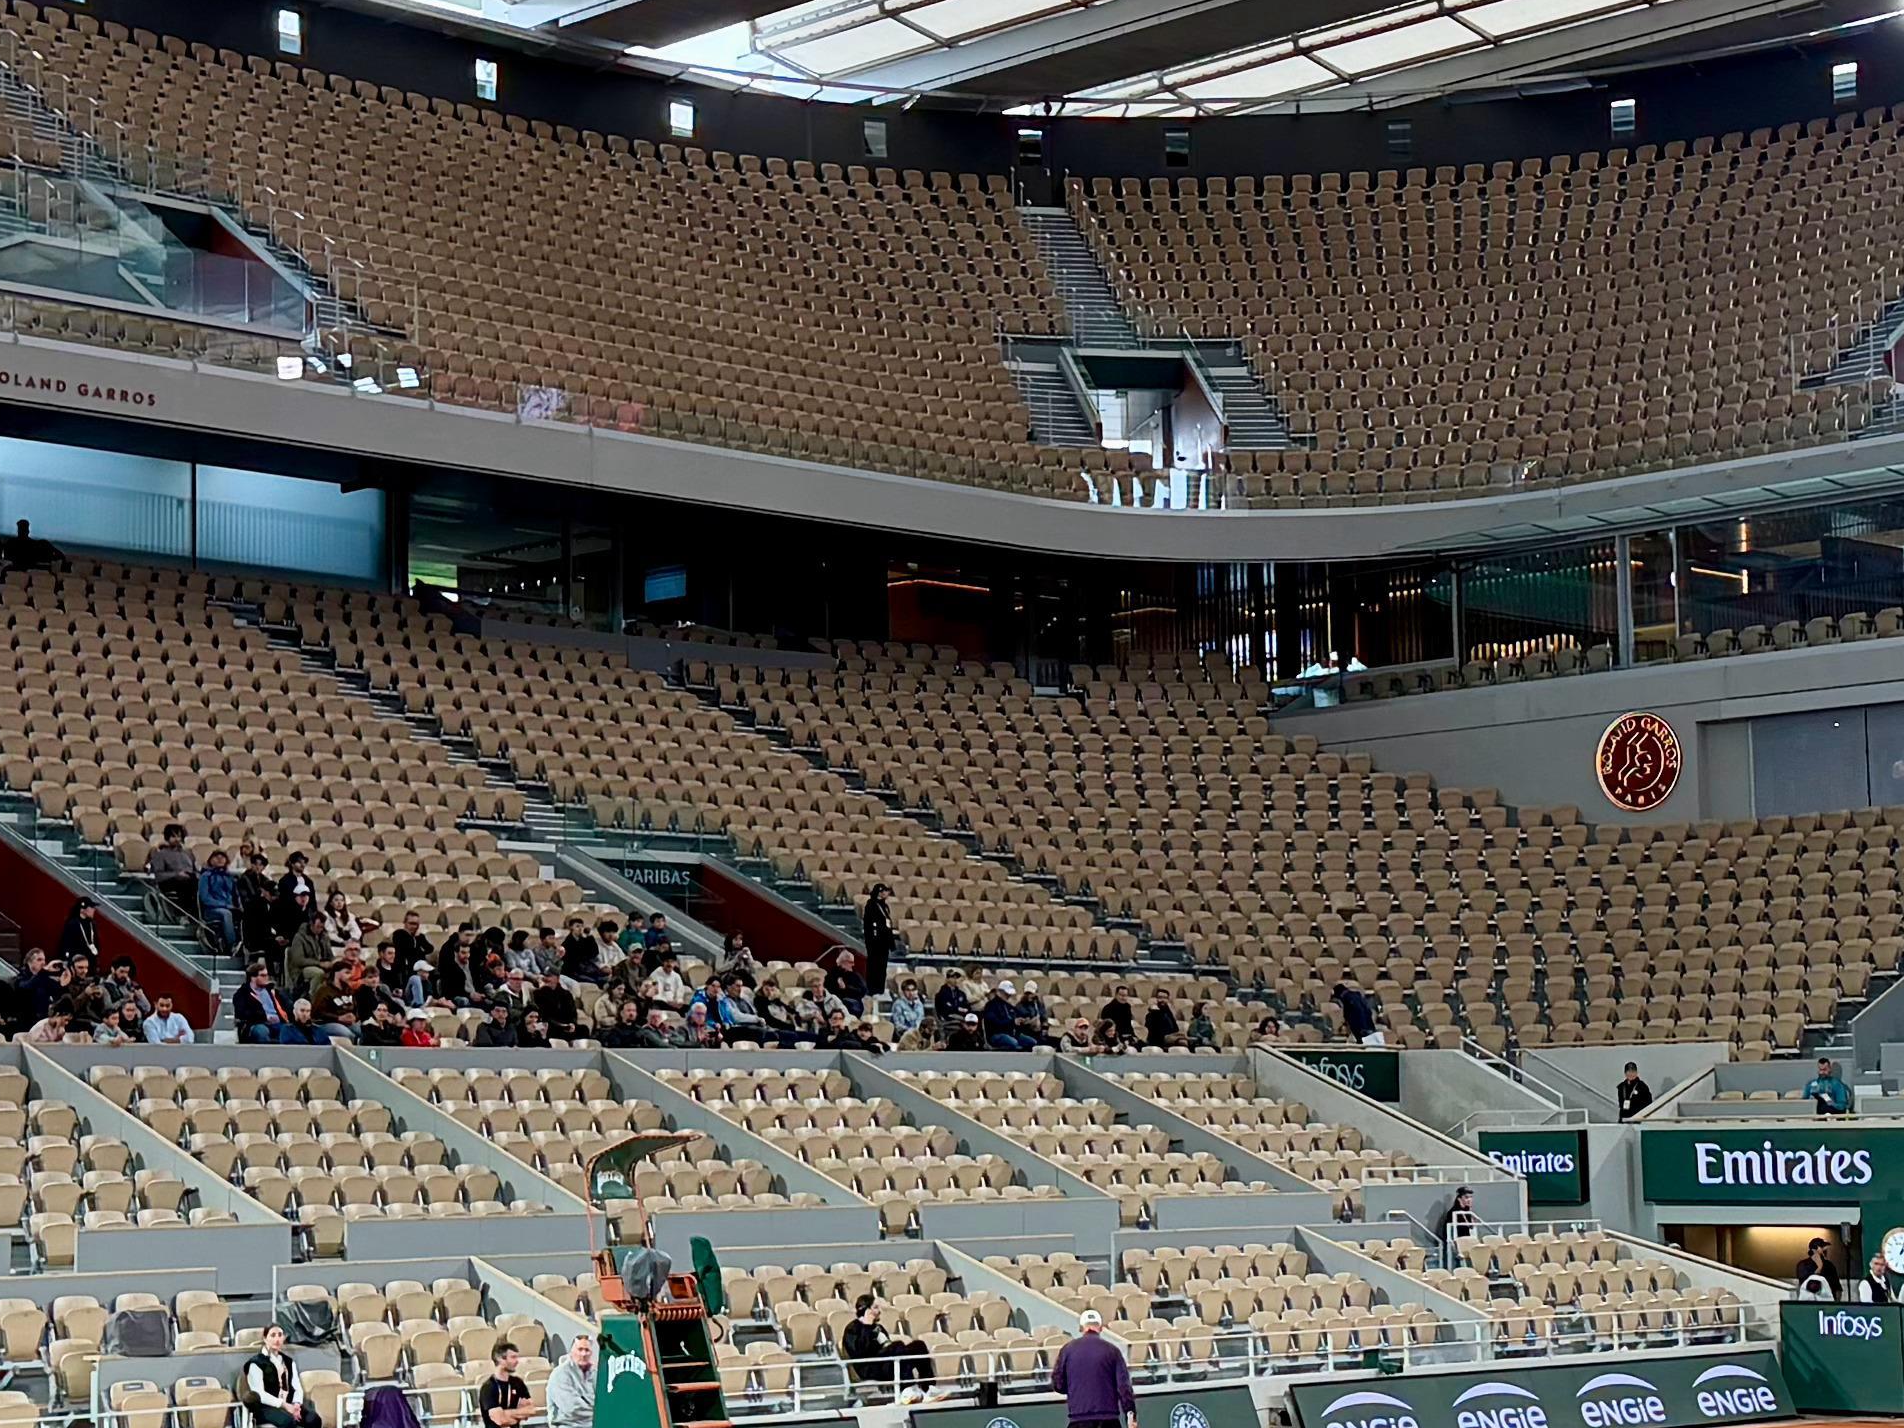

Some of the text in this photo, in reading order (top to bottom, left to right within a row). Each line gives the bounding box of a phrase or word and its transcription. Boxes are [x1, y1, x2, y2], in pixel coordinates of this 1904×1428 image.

[77, 383, 157, 407] GARROS
[624, 868, 691, 885] PARIBAS
[1489, 1149, 1575, 1174] Emirates
[1695, 1140, 1873, 1185] Emirates
[1818, 1310, 1883, 1341] Infosys
